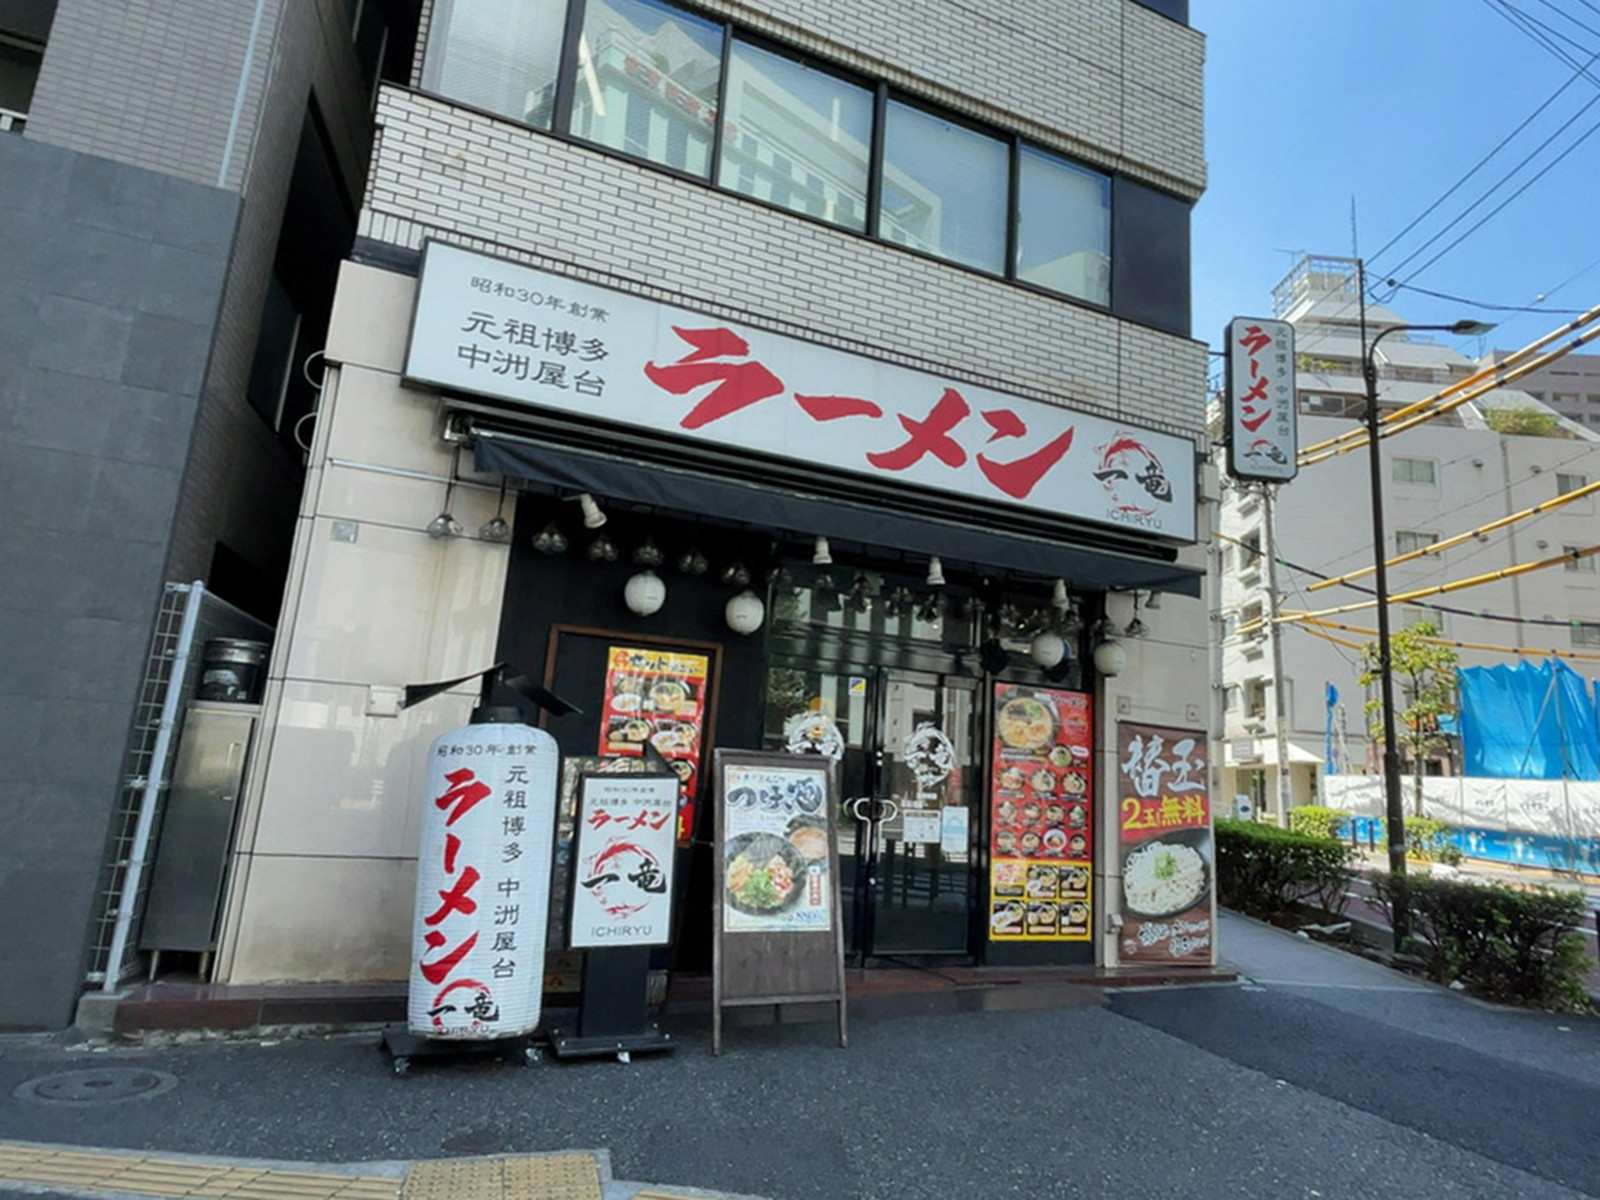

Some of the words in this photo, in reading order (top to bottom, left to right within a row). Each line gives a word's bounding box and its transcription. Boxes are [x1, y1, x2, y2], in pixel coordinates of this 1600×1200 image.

[470, 275, 610, 324] 昭和30年創業
[460, 310, 610, 364] 元祖博多
[457, 343, 607, 398] 中洲屋台
[1238, 325, 1272, 433] ラーメン
[643, 325, 1075, 499] ラーメン
[1093, 460, 1173, 503] 一竜
[1106, 508, 1162, 529] ICHIRYU
[436, 743, 538, 756] 昭和30年創業
[1121, 734, 1206, 797] 替玉
[502, 765, 530, 864] 元祖博多
[587, 809, 671, 831] ラーメン
[1122, 795, 1205, 830] 2玉無料
[419, 767, 492, 985] ラーメン
[581, 857, 667, 894] 一竜
[490, 877, 521, 980] 中洲屋台
[590, 925, 653, 937] ICHIRYU
[426, 991, 500, 1021] 一竜
